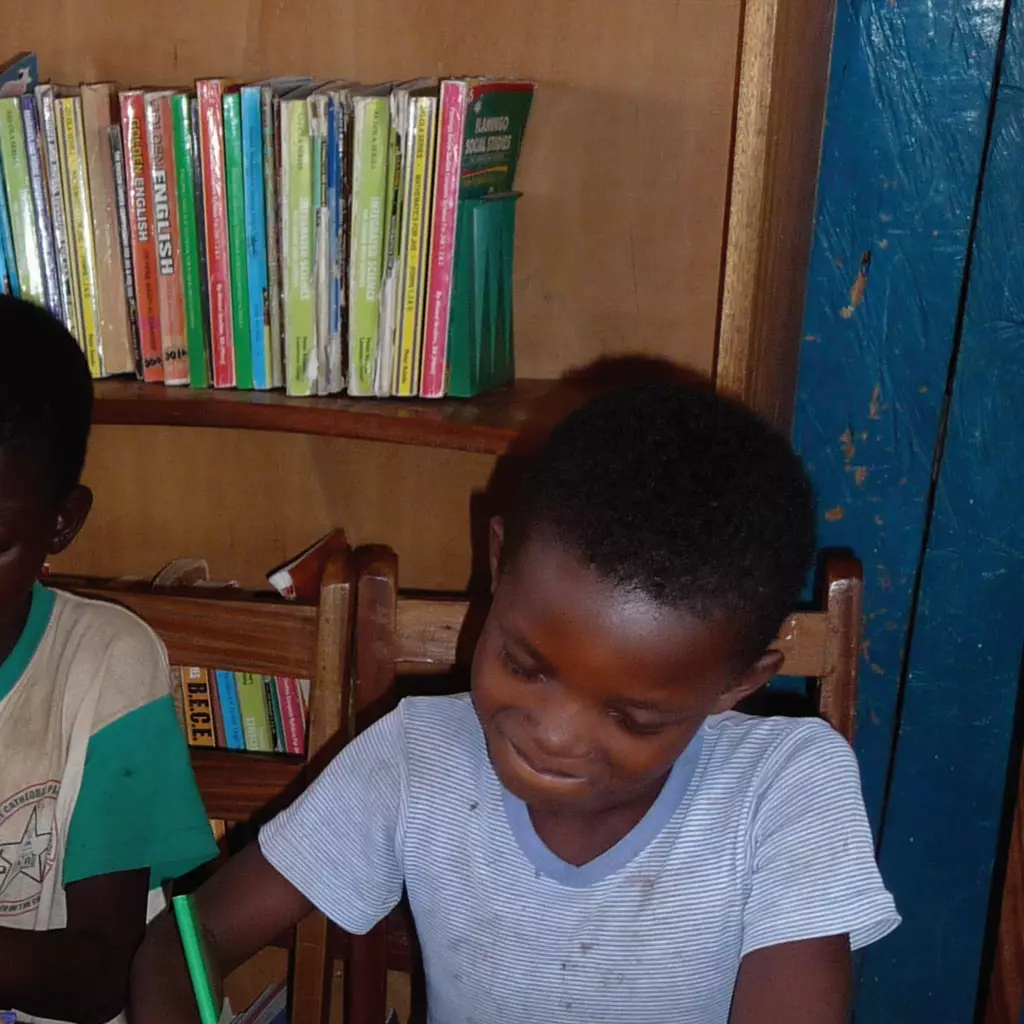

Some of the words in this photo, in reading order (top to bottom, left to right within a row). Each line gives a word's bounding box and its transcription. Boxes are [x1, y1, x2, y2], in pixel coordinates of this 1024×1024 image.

[128, 117, 144, 173] GOLDEN
[132, 176, 150, 240] ENGLISH
[151, 168, 175, 276] ENGLISH
[185, 681, 214, 742] B.E.C.E.
